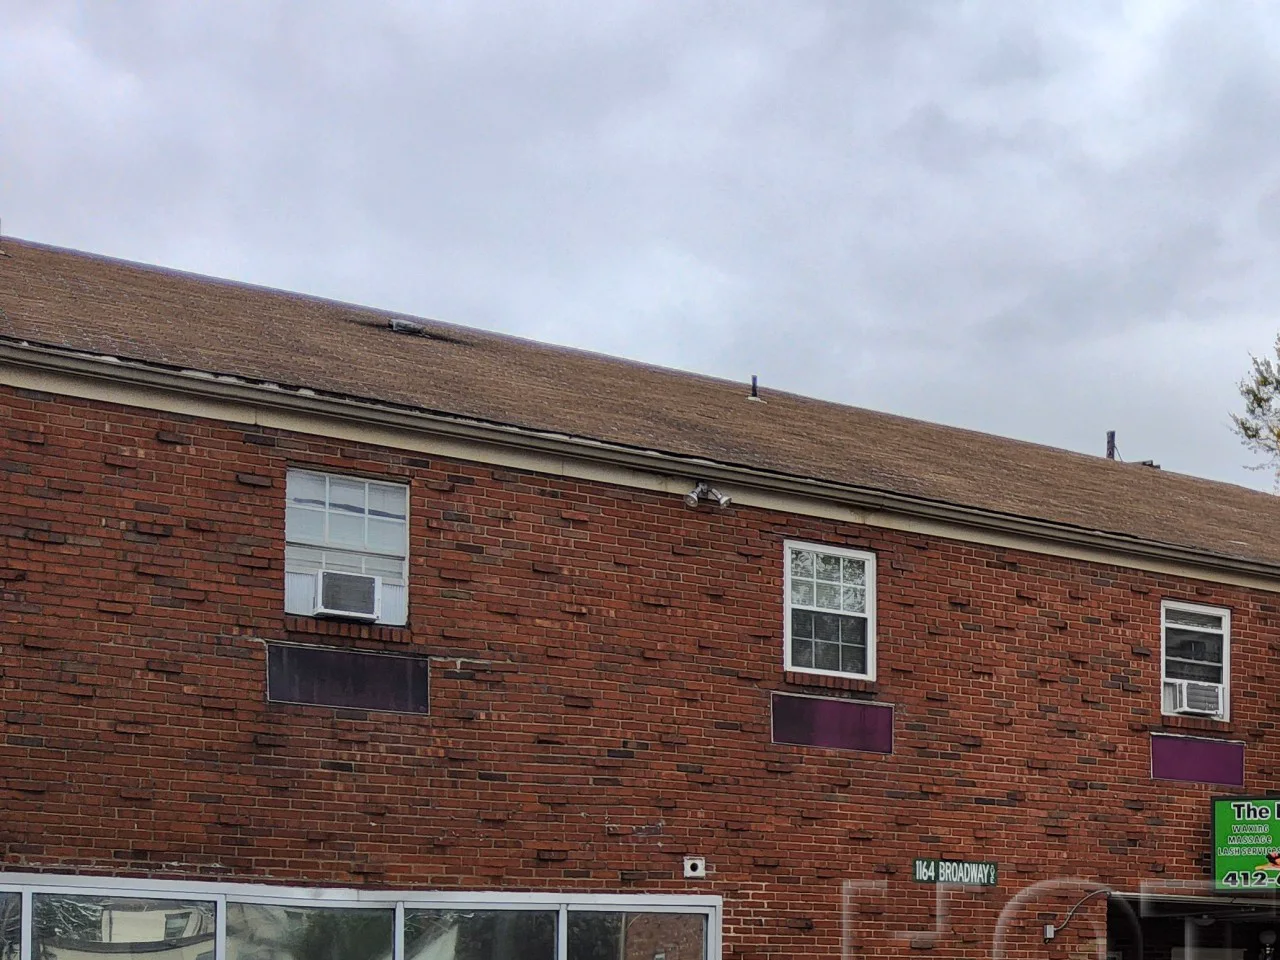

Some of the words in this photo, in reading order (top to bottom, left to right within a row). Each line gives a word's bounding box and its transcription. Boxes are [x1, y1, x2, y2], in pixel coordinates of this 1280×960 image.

[1232, 802, 1270, 819] The
[1218, 847, 1240, 856] LASH
[916, 860, 935, 880] 1164
[939, 861, 989, 883] BROADWAY
